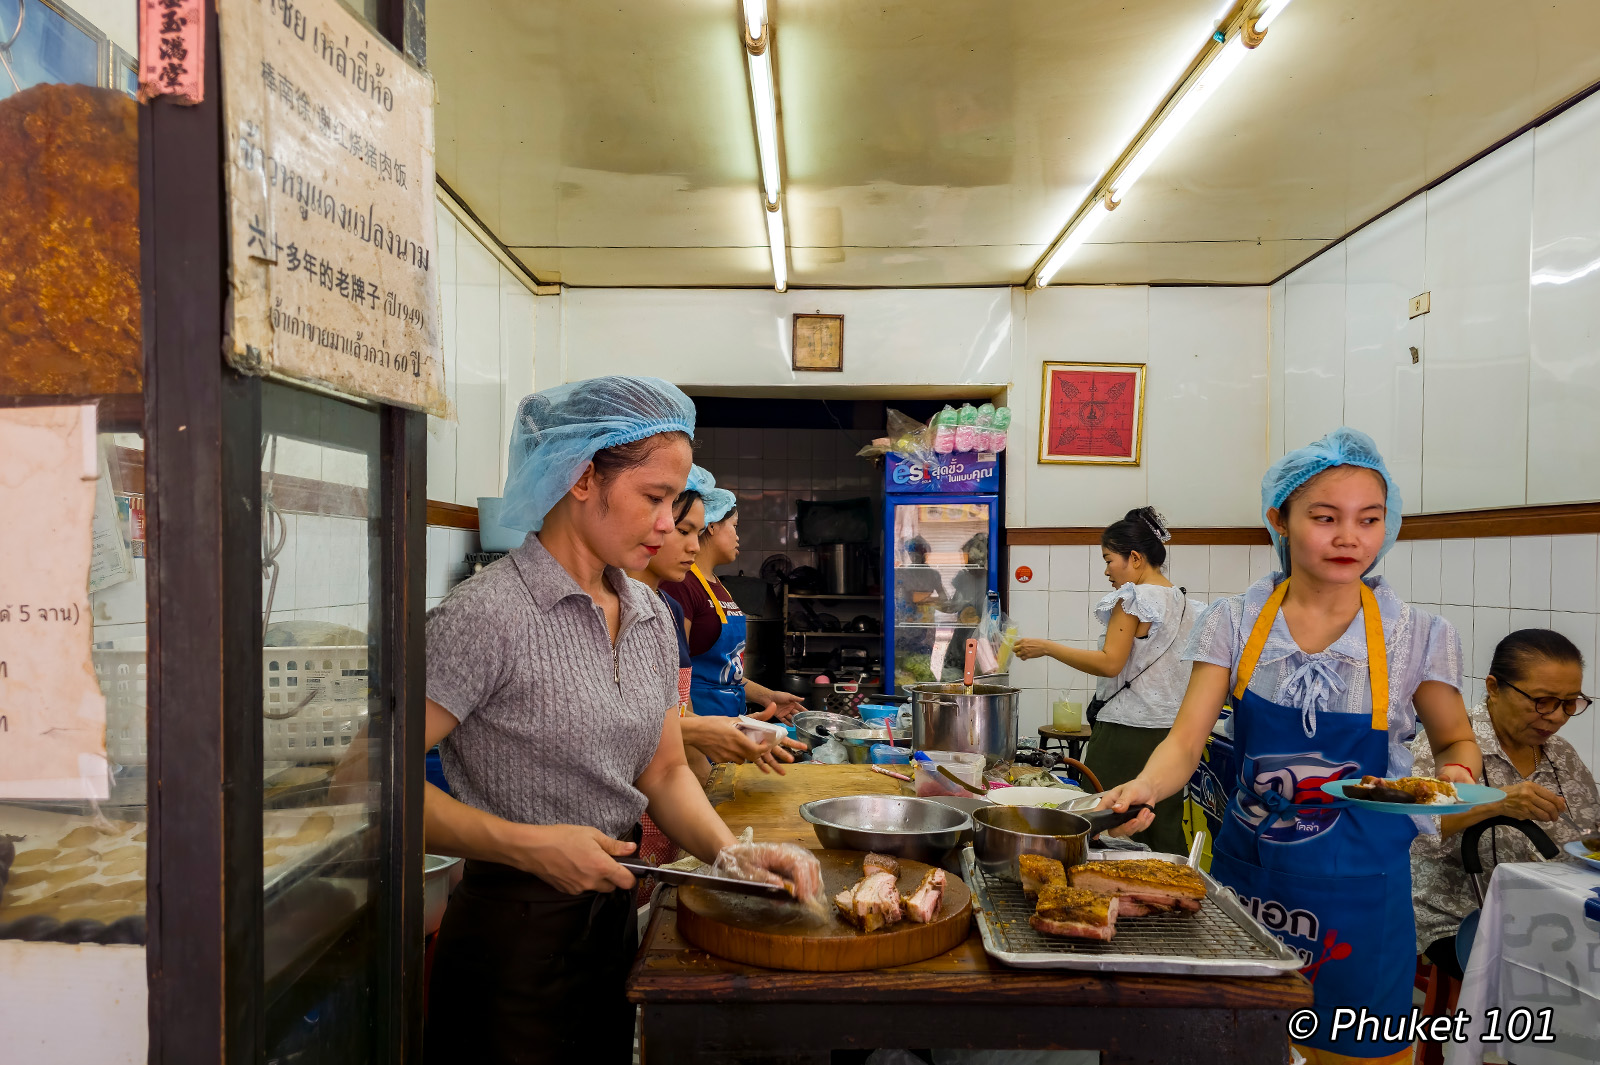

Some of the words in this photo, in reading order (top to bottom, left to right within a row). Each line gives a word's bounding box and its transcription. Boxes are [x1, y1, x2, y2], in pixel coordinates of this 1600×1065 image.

[313, 27, 394, 113] เหล่ายี่ห้อ
[239, 119, 430, 272] ข้าวหมูแดงแปลงนาม
[247, 213, 381, 311] 六十多年的老牌子
[269, 296, 390, 368] เจ้าเก่าขายมาแล้วกว่า
[393, 353, 408, 373] 60
[410, 350, 421, 378] ปี
[19, 604, 31, 622] 5
[38, 602, 80, 626] จาน)
[1295, 818, 1320, 833] โคล่า
